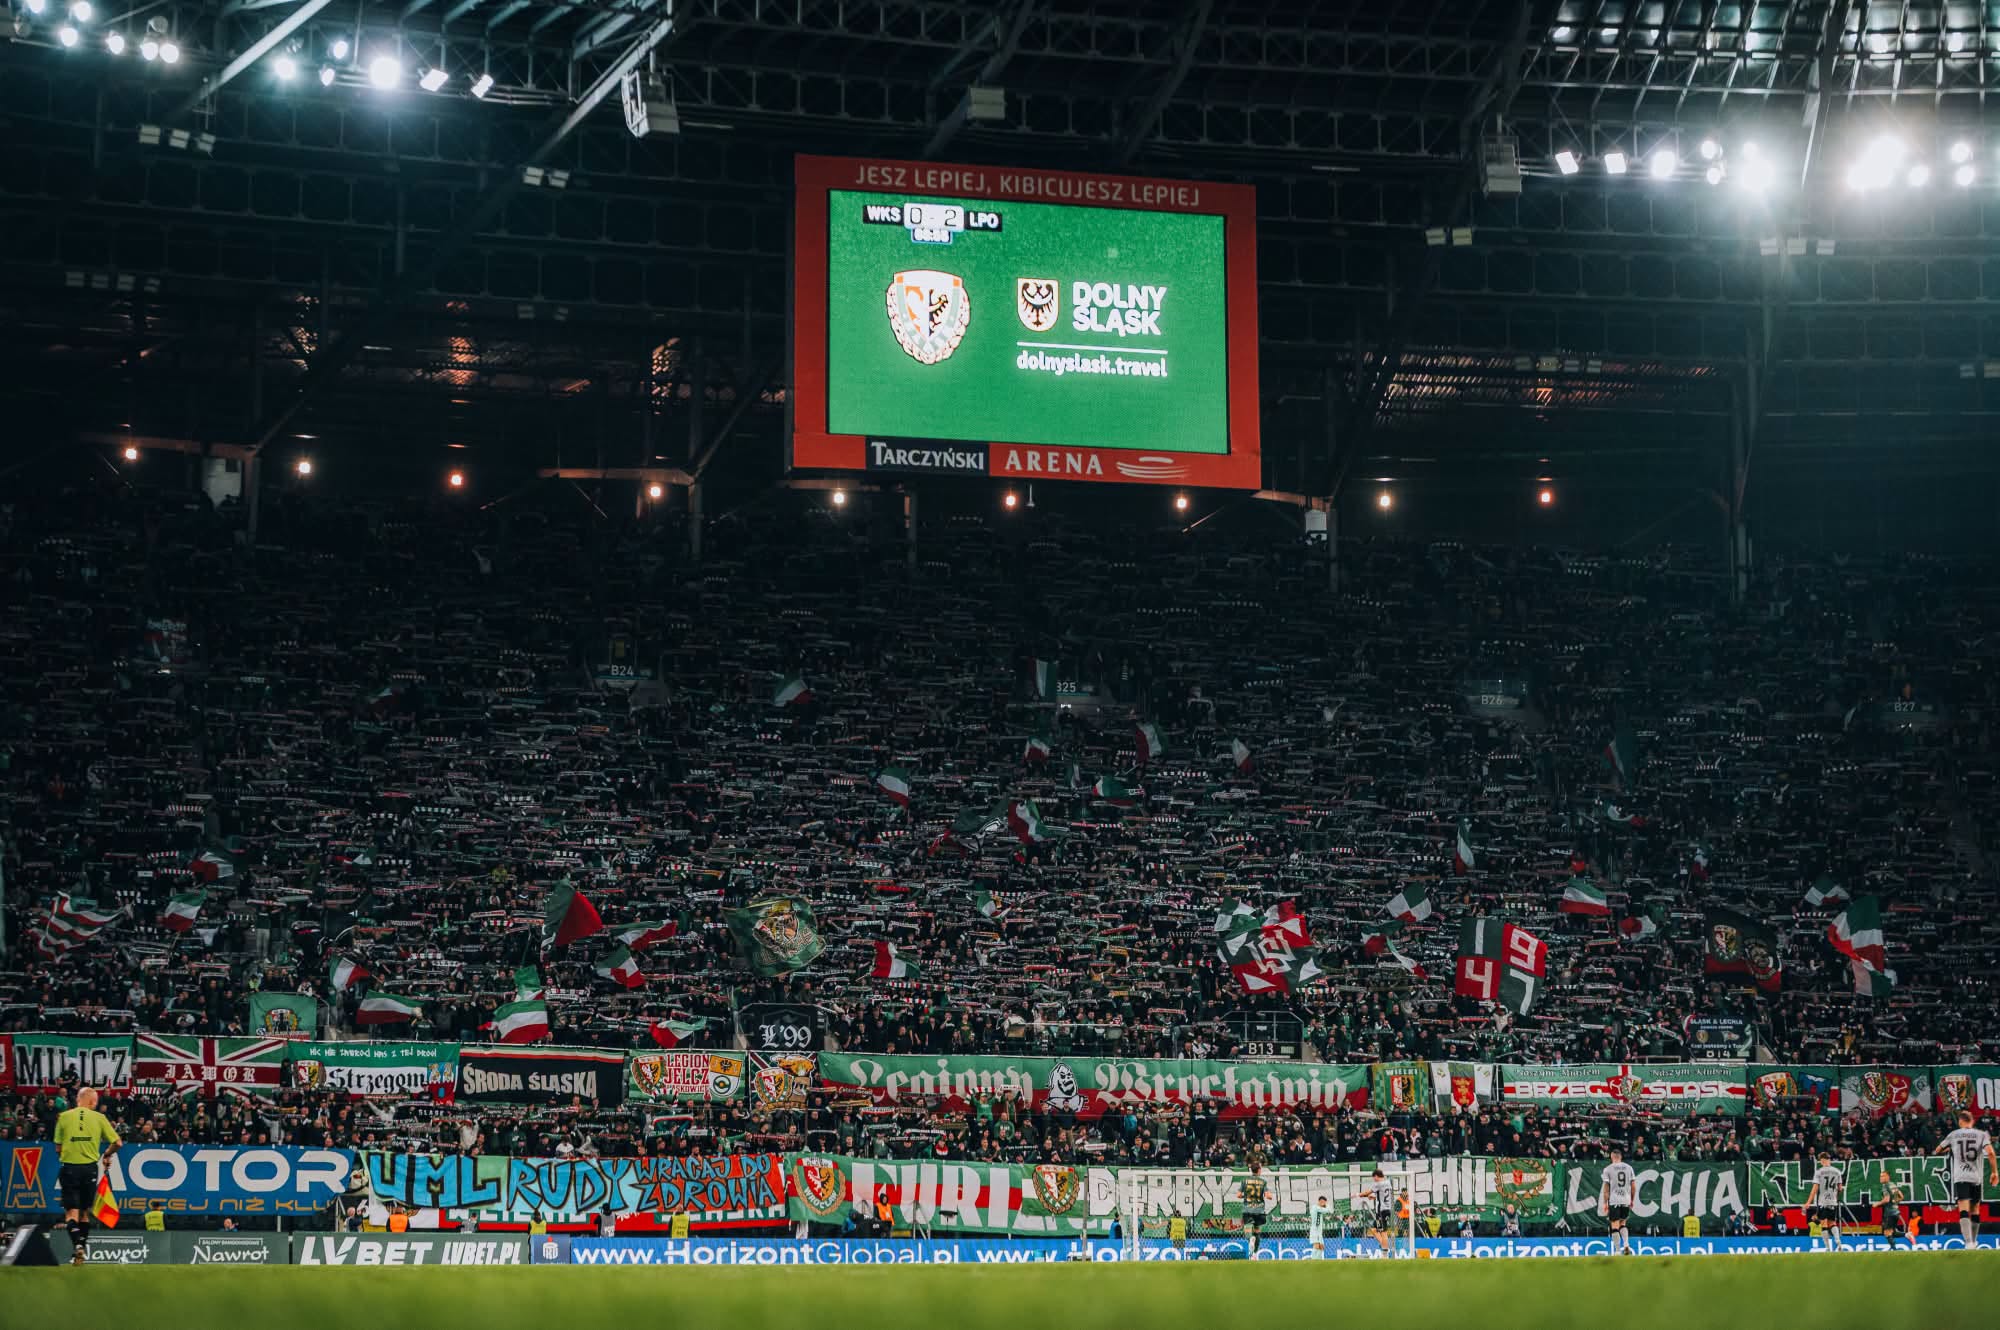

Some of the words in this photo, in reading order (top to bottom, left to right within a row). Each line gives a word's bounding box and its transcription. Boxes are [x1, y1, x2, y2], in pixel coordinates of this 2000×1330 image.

[856, 165, 907, 187] JESZ
[915, 169, 992, 195] LEPIEJ,
[1001, 175, 1124, 202] KIBICUJESZ
[1131, 184, 1200, 207] LEPIEJ
[867, 205, 901, 222] WKS
[944, 209, 957, 227] 2
[969, 211, 1000, 229] LPO
[1072, 280, 1168, 311] DOLNY
[1016, 350, 1168, 378] dolnyslask.travel
[1005, 449, 1104, 476] ARENA
[611, 664, 634, 676] B24
[1481, 694, 1503, 706] B26
[1894, 701, 1916, 712] B27
[667, 1053, 710, 1068] LEGION
[1248, 1042, 1274, 1055] B13
[325, 1068, 427, 1093] Strzegom
[463, 1063, 523, 1095] ŚRODA
[529, 1071, 597, 1099] ŚLĄSKA
[664, 1067, 710, 1085] JELCZ
[1515, 1081, 1602, 1099] BRZEG
[1957, 1139, 1978, 1162] 15
[634, 1155, 732, 1181] WRACAJ
[740, 1155, 772, 1179] DO
[1617, 1171, 1626, 1188] 9
[368, 1152, 500, 1209] UML
[506, 1156, 634, 1212] RUDY
[629, 1176, 778, 1212] ZDROWIA
[1088, 1167, 1232, 1216] DERBY
[1566, 1166, 1745, 1219] LCHIA
[1748, 1156, 1951, 1207] KLMEK
[1823, 1175, 1836, 1191] 14
[117, 1197, 208, 1212] IĘCEJ
[275, 1197, 335, 1212] KLU
[190, 1245, 270, 1264] Nawrot
[440, 1240, 522, 1265] LVBET.PL
[573, 1240, 960, 1265] www.HorizontGlobal.pl
